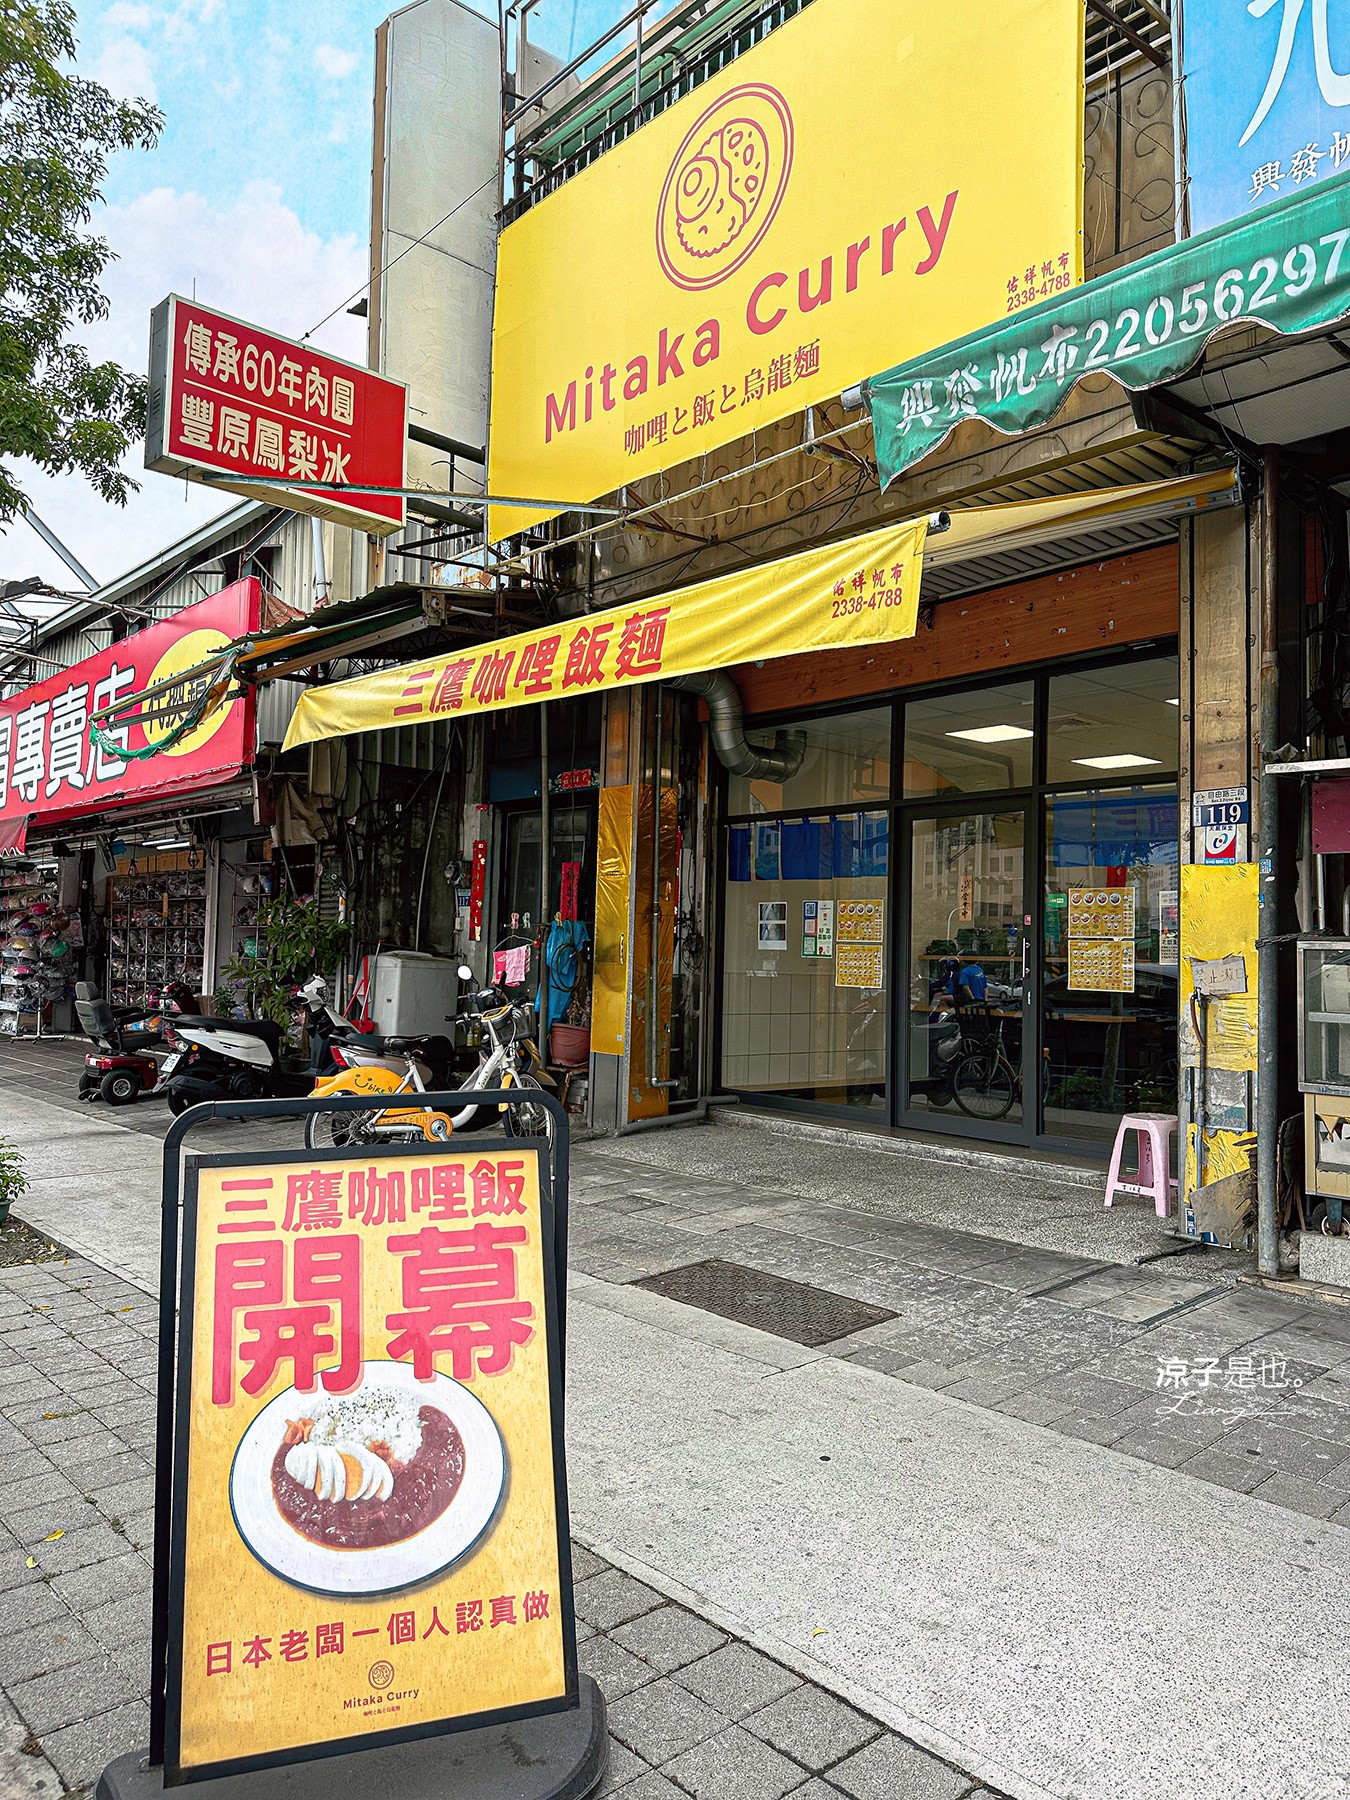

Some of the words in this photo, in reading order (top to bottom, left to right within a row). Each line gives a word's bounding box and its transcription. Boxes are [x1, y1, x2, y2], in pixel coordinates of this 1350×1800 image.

[1006, 252, 1069, 293] 佑祥帆布
[1006, 271, 1071, 313] 2338-4788
[543, 318, 721, 444] Mitaka
[745, 189, 960, 336] Curry
[183, 319, 355, 426] 傳承60年肉圓
[624, 337, 821, 457] 咖哩と飯と烏龍麵
[179, 392, 352, 484] 豐原鳳梨冰
[831, 587, 903, 619] 2338-4788
[833, 563, 904, 597] 佑祥帆布
[393, 606, 672, 717] 三鷹咖哩飯麵
[1206, 803, 1242, 825] 119
[458, 896, 470, 906] 117
[217, 1159, 527, 1234] 三鷹咖哩飯
[211, 1222, 536, 1409] 開幕
[205, 1589, 551, 1678] 日本老闆一個人認真做
[343, 1695, 383, 1709] Mitaka
[386, 1689, 420, 1701] Curry
